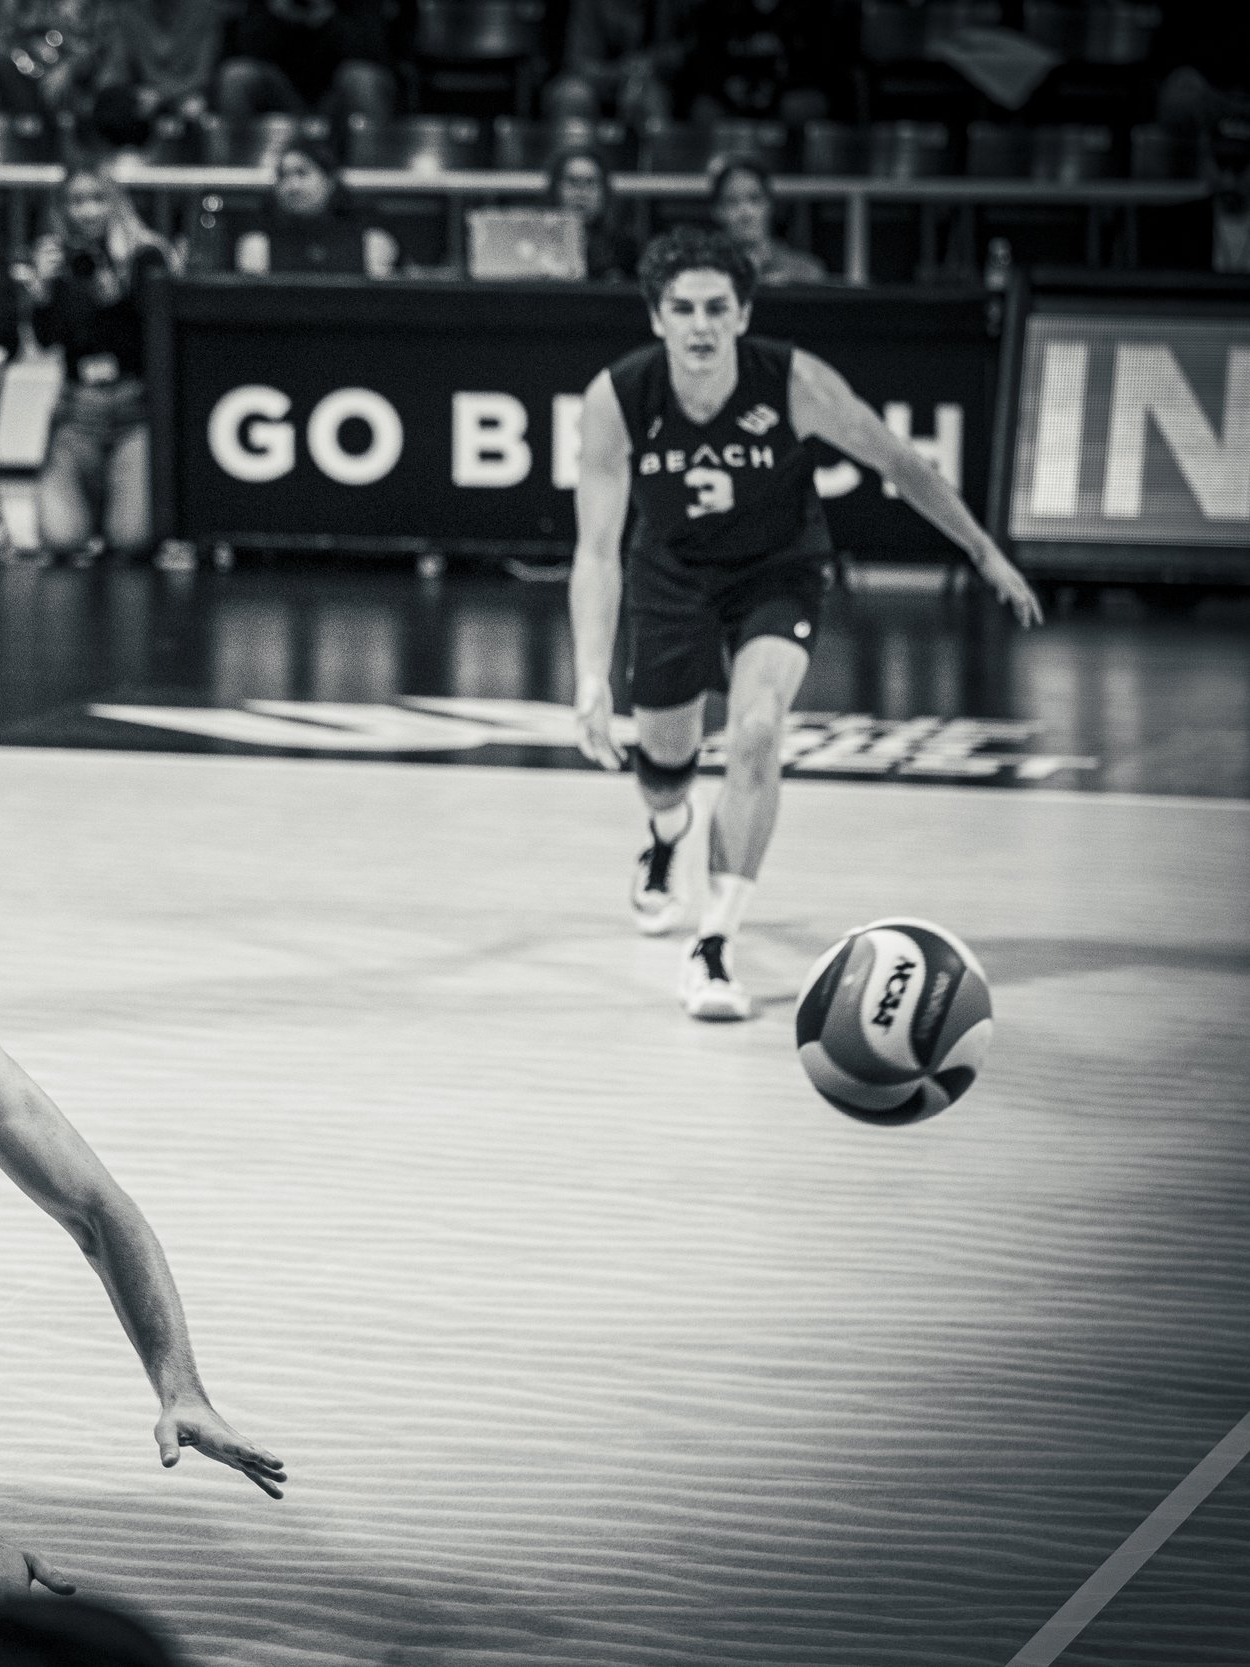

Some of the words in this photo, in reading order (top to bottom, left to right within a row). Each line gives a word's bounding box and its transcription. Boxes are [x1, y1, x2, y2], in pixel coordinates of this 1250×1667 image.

[207, 384, 404, 486] GO
[639, 443, 774, 475] BEACH
[684, 466, 735, 518] 3
[871, 957, 916, 1034] NCAA
